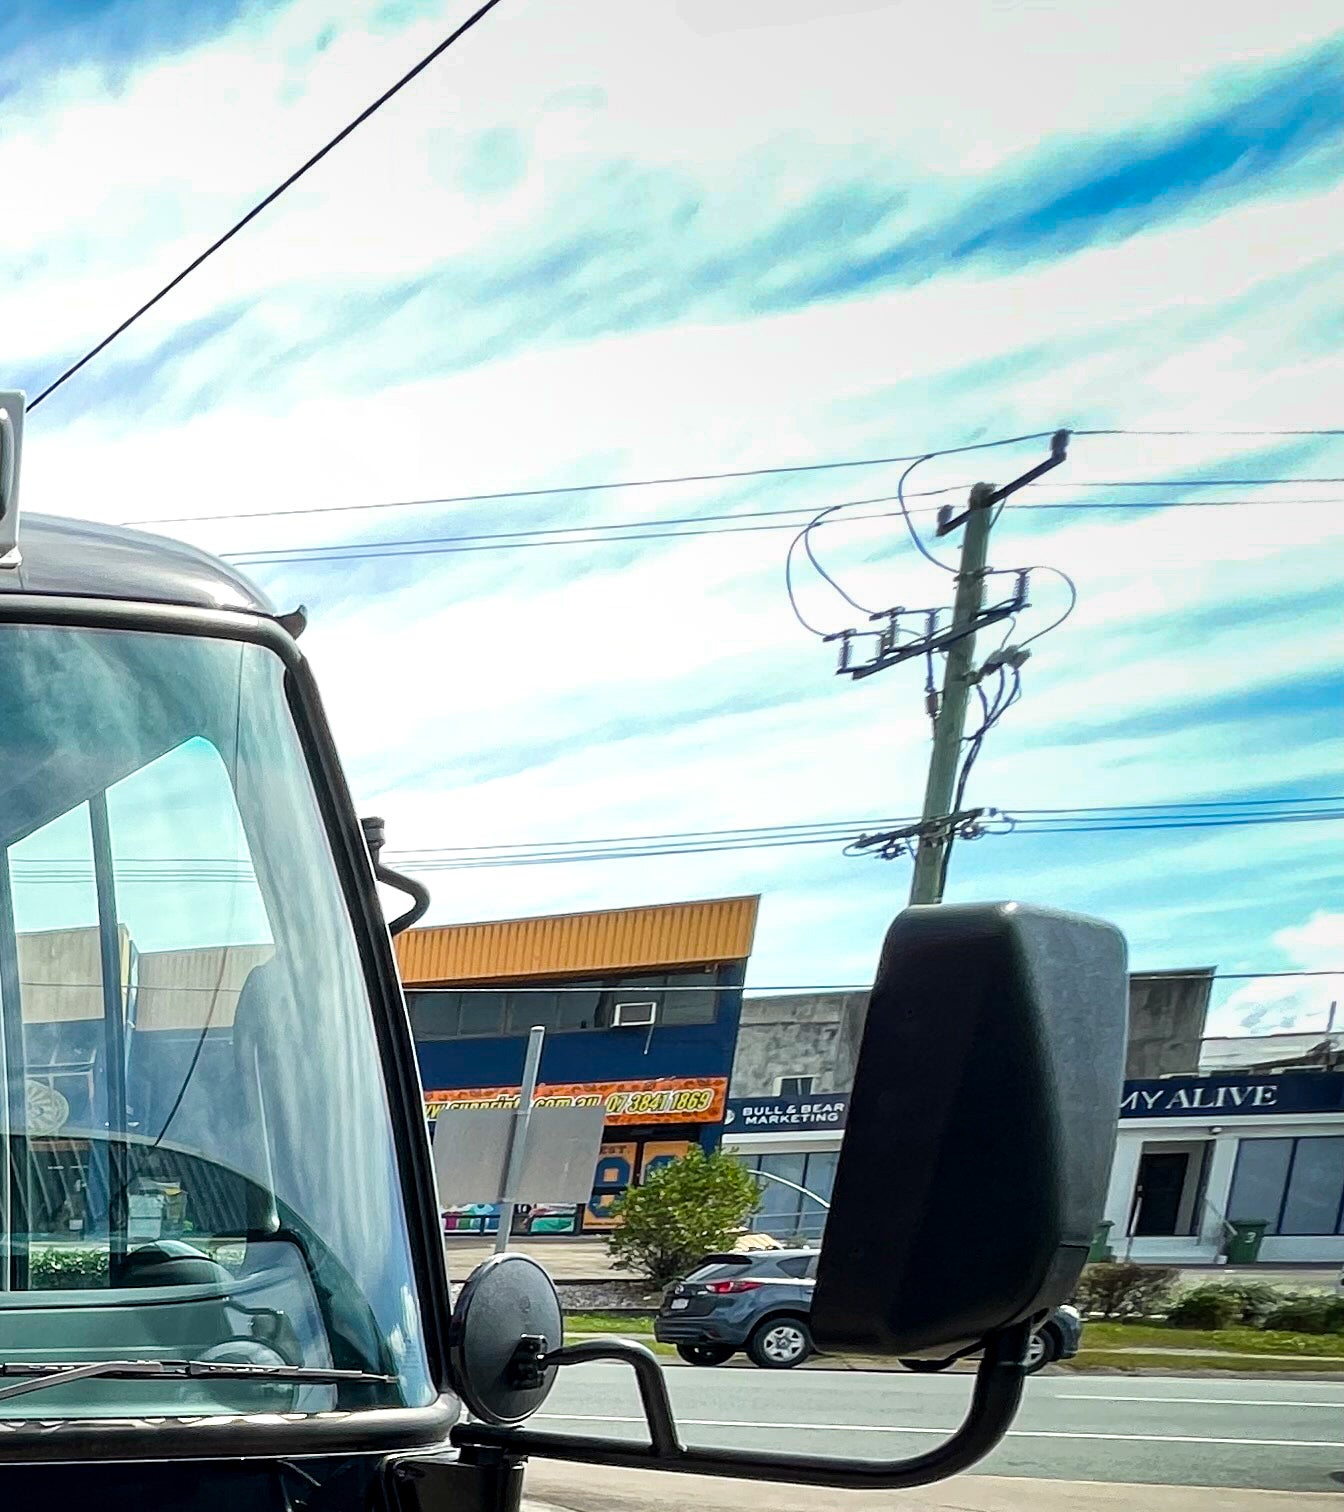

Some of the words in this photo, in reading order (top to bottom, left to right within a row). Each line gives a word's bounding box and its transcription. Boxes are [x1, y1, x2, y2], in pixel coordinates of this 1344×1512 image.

[605, 1092, 630, 1114] 07
[628, 1092, 670, 1113] 3841
[670, 1090, 714, 1112] 1869
[1165, 1085, 1280, 1109] ALIVE
[742, 1105, 783, 1117] BULL
[786, 1104, 796, 1115] &
[800, 1102, 845, 1114] BEAR
[745, 1113, 839, 1125] MARKETING
